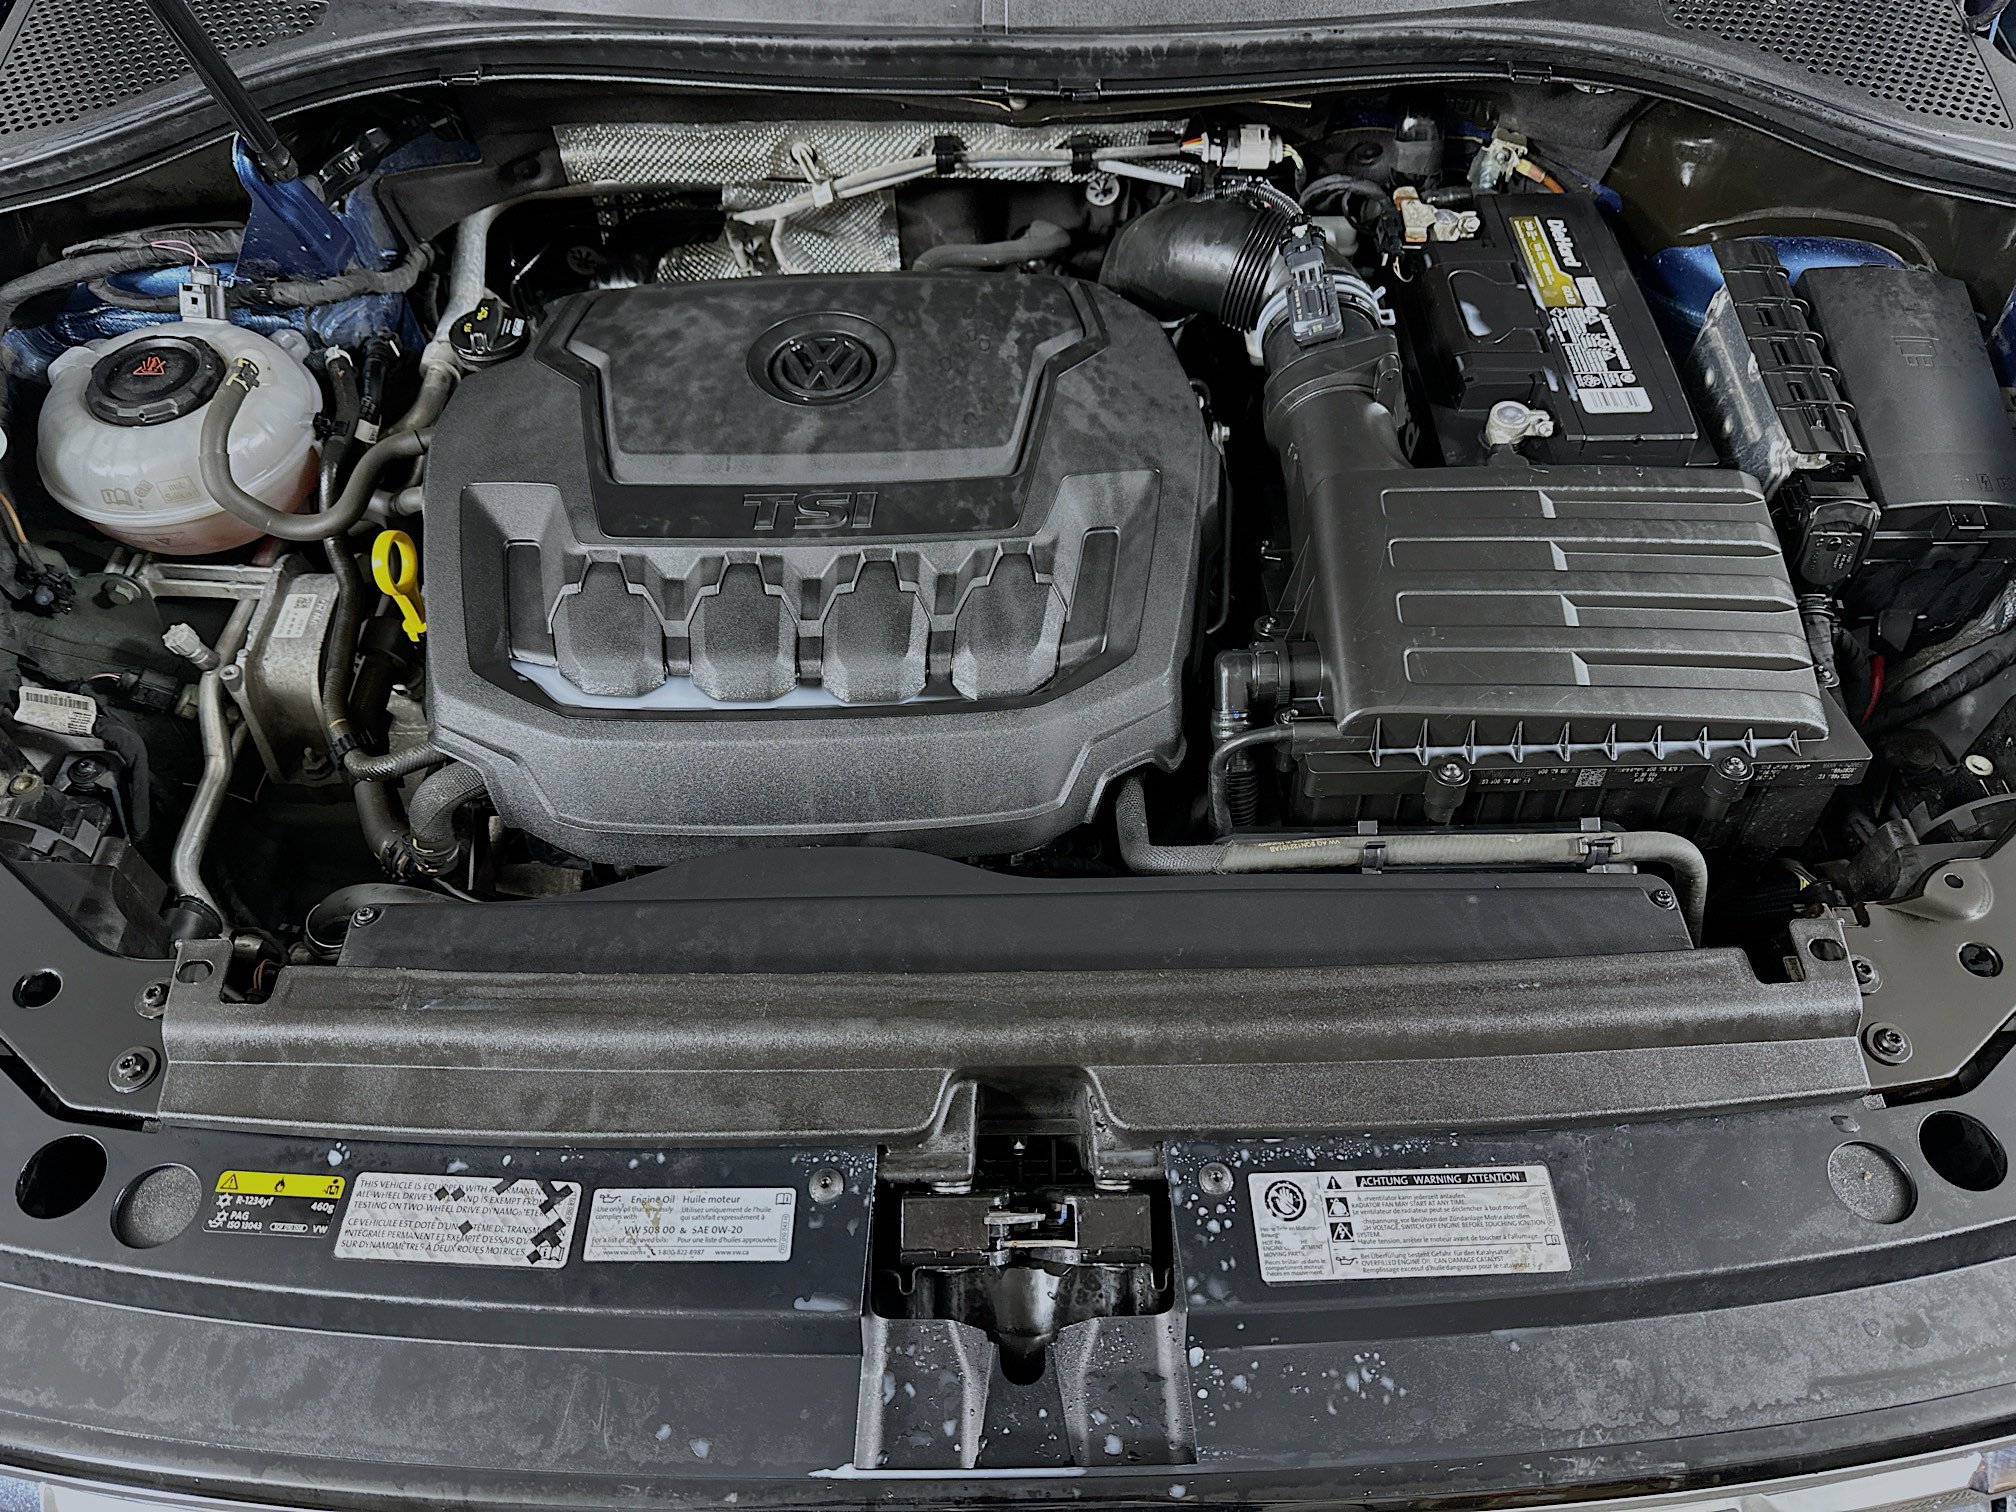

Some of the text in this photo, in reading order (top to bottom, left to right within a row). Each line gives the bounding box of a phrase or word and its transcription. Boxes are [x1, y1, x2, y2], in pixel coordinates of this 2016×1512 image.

[1546, 219, 1582, 267] DieHard
[743, 491, 879, 530] TSI
[1360, 1172, 1521, 1186] ACHTUNG WARNING ATTENTION
[360, 1179, 379, 1188] THIS
[380, 1180, 413, 1190] VEHICLE
[414, 1182, 422, 1190] IS
[465, 1184, 488, 1193] WITH
[235, 1195, 275, 1209] R-1234yf
[356, 1190, 401, 1200] ALL-WHEEL
[402, 1191, 428, 1200] DRIVE
[460, 1195, 479, 1204] AND
[480, 1195, 488, 1203] IS
[489, 1196, 521, 1206] EXEMPT
[631, 1195, 740, 1206] Engine Oil Huile moteur
[310, 1201, 336, 1214] 460g
[353, 1200, 481, 1214] TESTING ON TWO-WHEEL DRIVE
[229, 1210, 250, 1221] PAG
[595, 1213, 623, 1221] complies
[680, 1214, 691, 1222] qui
[226, 1221, 240, 1230] ISO
[313, 1224, 329, 1234] VW
[347, 1217, 358, 1226] CE
[399, 1219, 414, 1228] EST
[495, 1224, 505, 1233] DE
[624, 1226, 641, 1235] VW
[643, 1226, 660, 1235] 508
[662, 1226, 676, 1234] 00
[691, 1226, 709, 1235] SAE
[711, 1226, 743, 1235] 0W-20
[387, 1230, 437, 1240] PERMANENT
[437, 1232, 445, 1240] ET
[341, 1239, 358, 1248] SUR
[433, 1243, 455, 1253] DEUX
[457, 1244, 484, 1254] ROUES
[1408, 1250, 1430, 1258] besteht
[1361, 1258, 1397, 1266] OVERFILLED
[1397, 1257, 1420, 1265] ENGINE
[1433, 1256, 1448, 1264] CAN
[1448, 1256, 1475, 1264] DAMAGE
[1362, 1265, 1400, 1274] Remplissage
[1445, 1263, 1477, 1272] dangereux
[1478, 1263, 1492, 1271] pour
